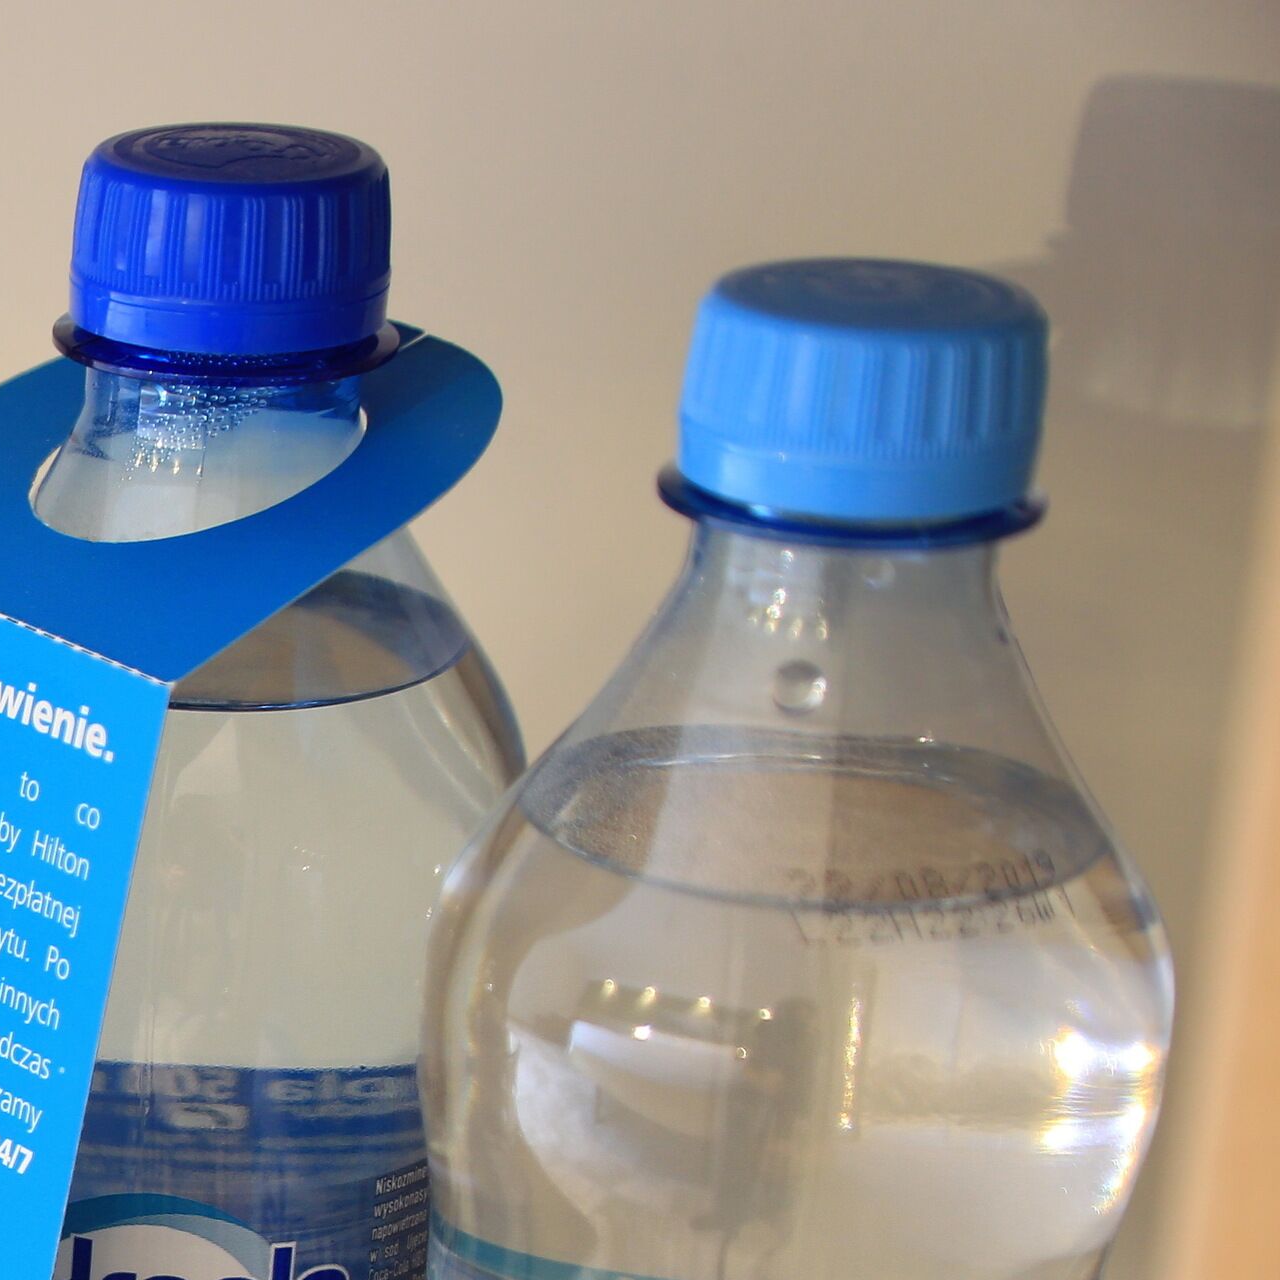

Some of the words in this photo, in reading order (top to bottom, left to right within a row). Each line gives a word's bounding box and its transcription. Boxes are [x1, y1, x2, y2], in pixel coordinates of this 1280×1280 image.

[19, 771, 40, 802] to
[75, 802, 101, 831] co
[31, 830, 90, 881] Hilton
[44, 944, 71, 981] Po
